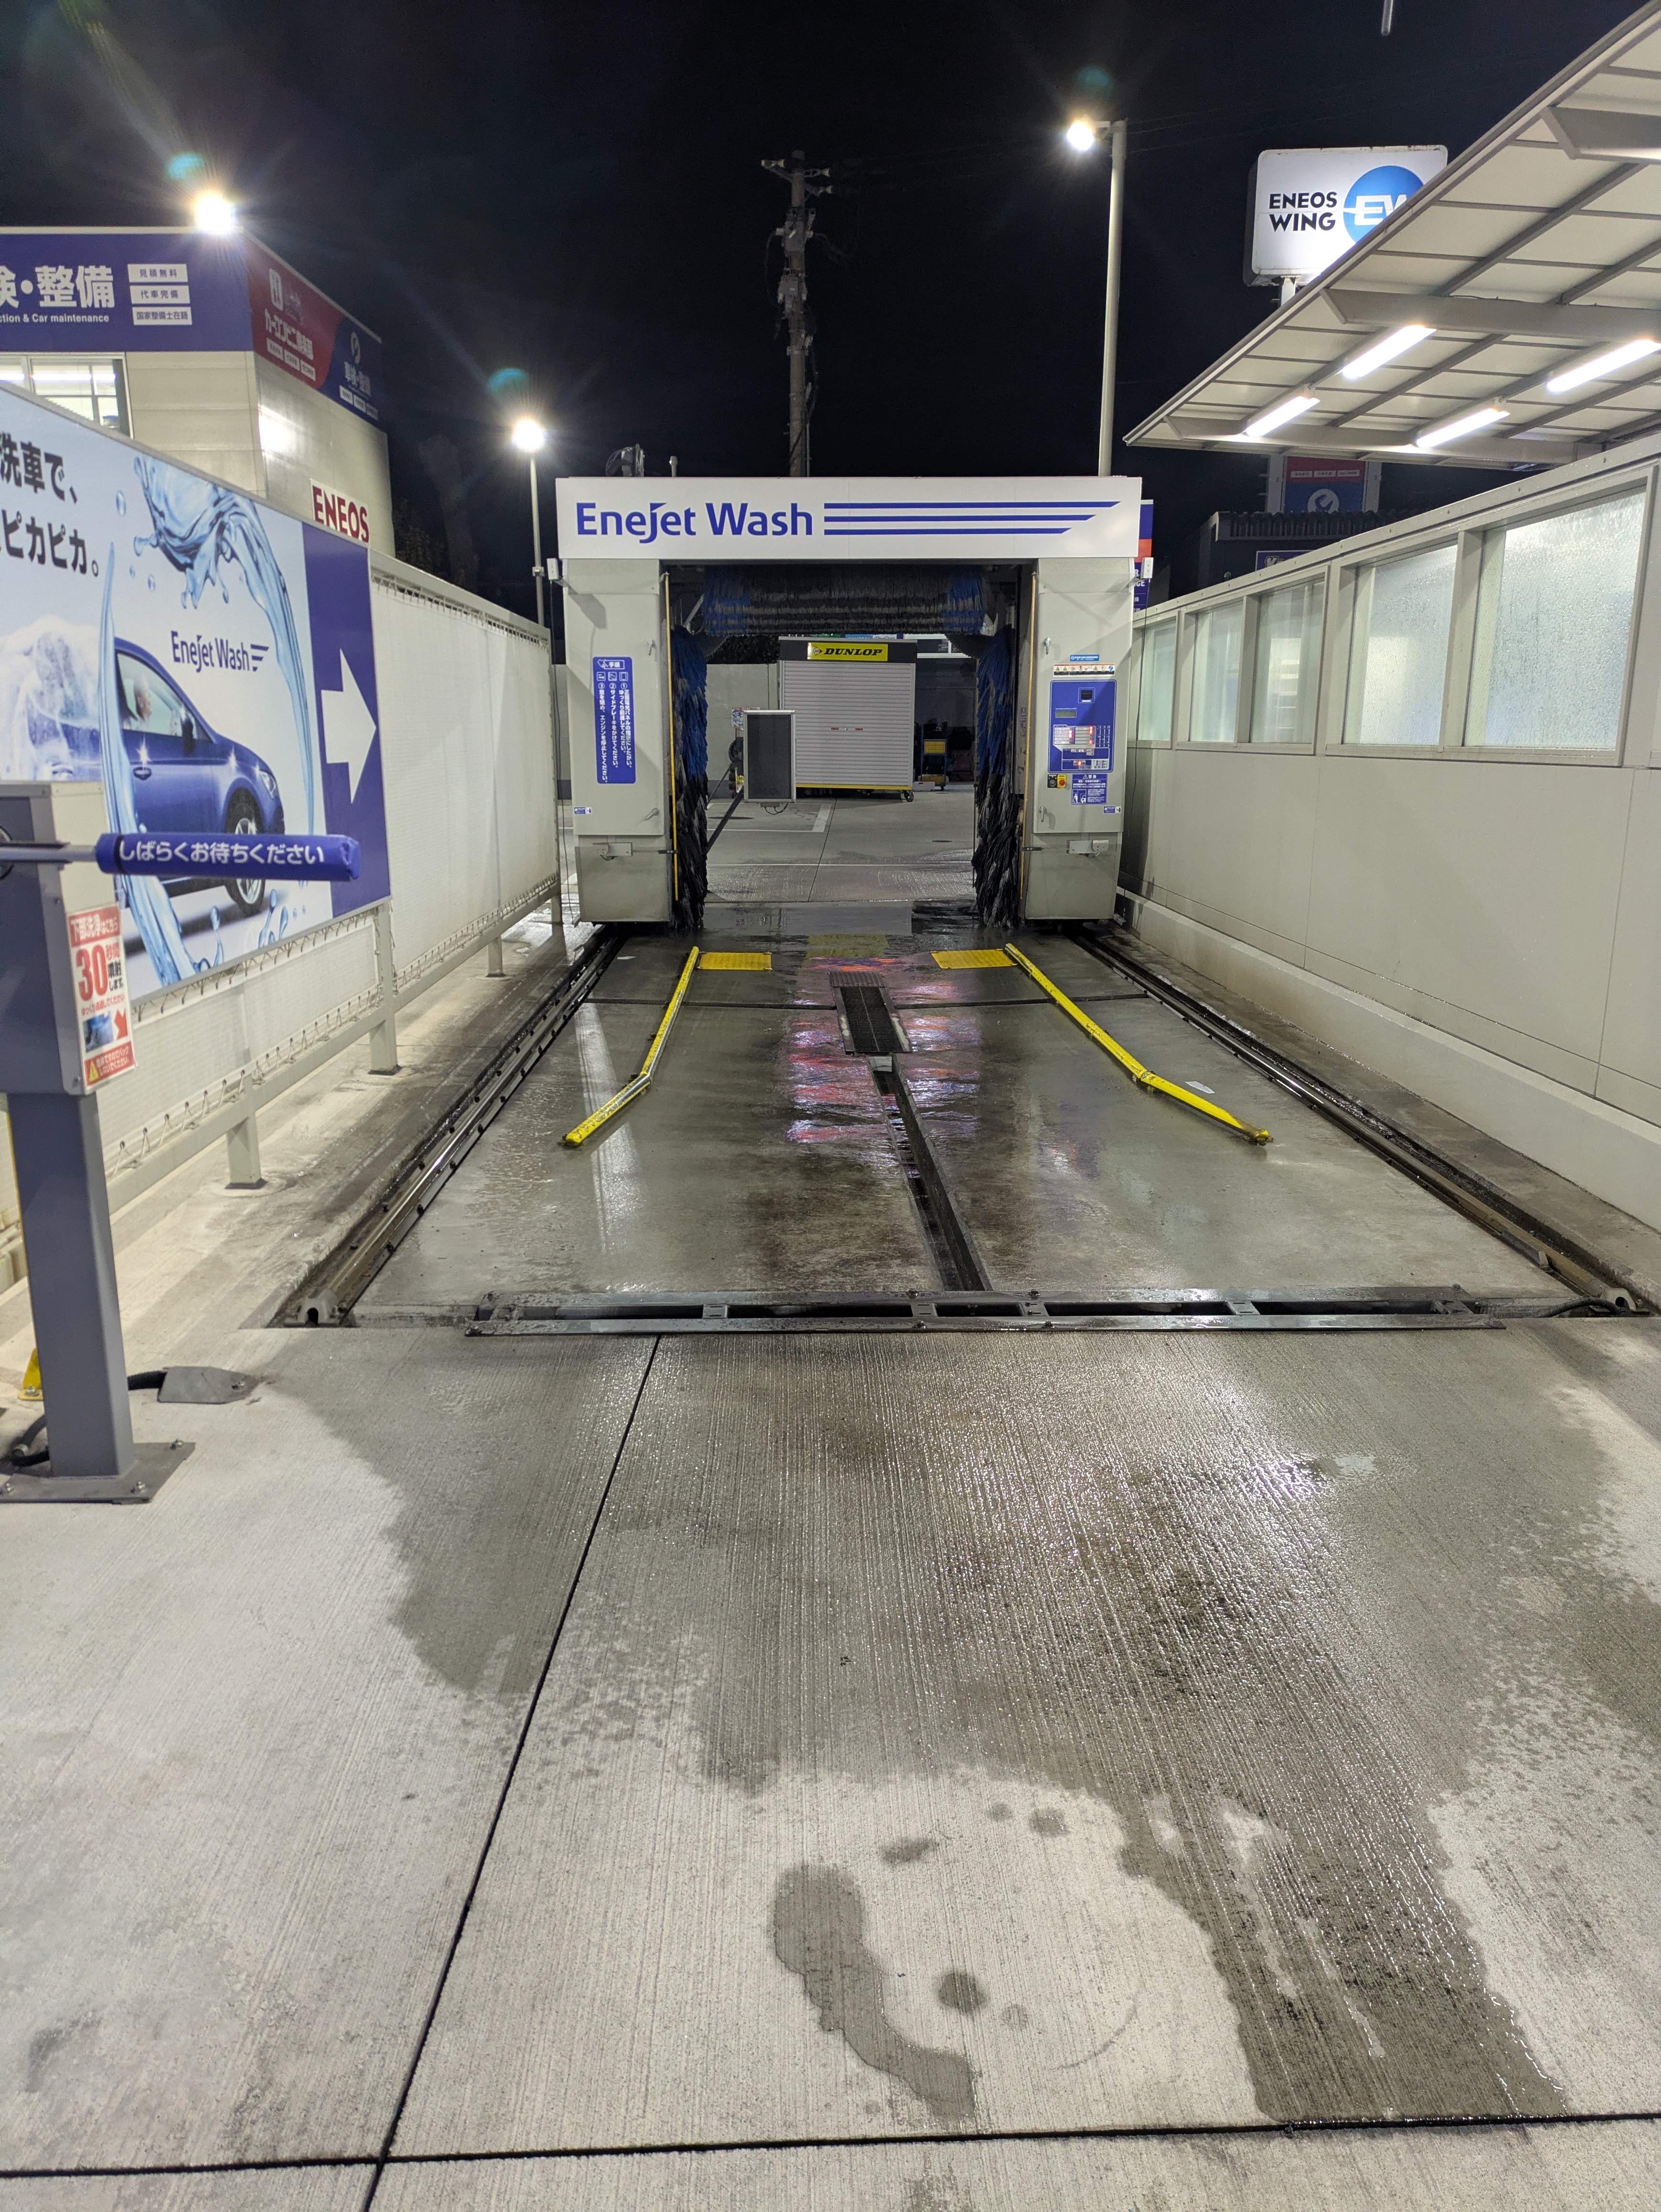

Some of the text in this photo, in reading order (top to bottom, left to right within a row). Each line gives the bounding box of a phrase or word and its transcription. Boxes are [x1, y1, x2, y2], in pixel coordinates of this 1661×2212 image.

[1269, 191, 1338, 210] ENEOS
[1269, 212, 1336, 232] WING
[139, 268, 177, 278] 見積無料
[140, 289, 178, 299] 代車完備
[23, 313, 29, 323] &
[32, 313, 48, 323] Car
[50, 313, 109, 323] maintenance
[312, 485, 369, 543] ENEOS
[705, 502, 812, 536] Wash
[215, 637, 250, 672] Wash
[824, 648, 883, 656] DUNLOP
[119, 841, 324, 864] しばらくお待ちください
[76, 944, 108, 1001] 30
